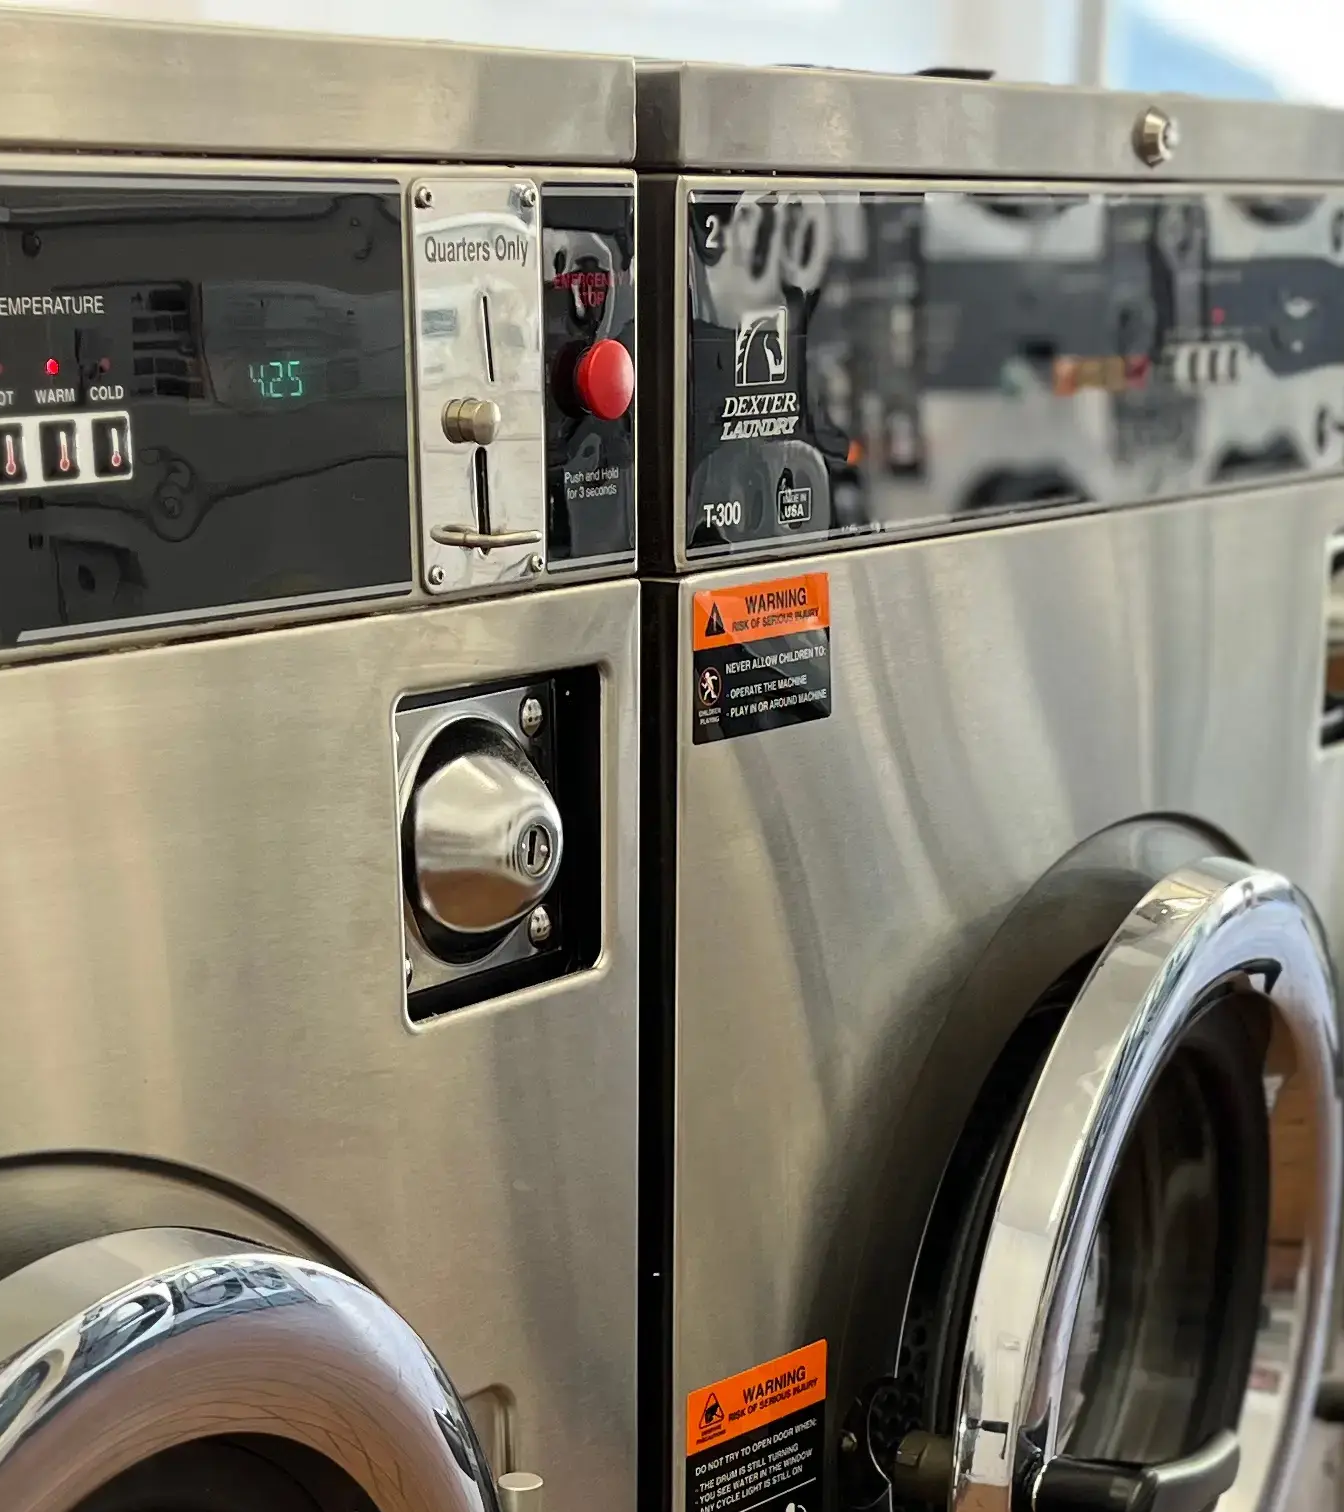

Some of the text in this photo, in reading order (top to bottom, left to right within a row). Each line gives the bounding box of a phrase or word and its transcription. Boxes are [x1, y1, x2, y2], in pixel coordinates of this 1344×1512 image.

[425, 235, 528, 267] Quarters Only
[552, 272, 623, 289] EMERGENY
[579, 291, 604, 308] TOP
[35, 388, 75, 404] WARM
[90, 385, 124, 401] COLD
[721, 392, 797, 418] DEXTER
[720, 416, 799, 440] LAUNDRY
[564, 467, 618, 483] Push and Hold
[567, 484, 617, 499] for 3 seconds
[704, 501, 804, 528] T-300 USA
[745, 588, 806, 615] WARNING
[732, 620, 749, 632] RISK
[751, 618, 760, 629] OF
[762, 612, 793, 627] SERIOUS
[726, 646, 826, 674] NEVER ALLOW CHILDREN TO:
[730, 674, 807, 699] OPERATE THE MACHINE
[730, 689, 827, 718] PLAY IN OR AROUND MACHINE
[743, 1366, 806, 1404] WARNING
[728, 1377, 818, 1422] RISK OF SERIOUS INJURY
[695, 1464, 706, 1477] DO
[708, 1457, 723, 1471] NOT
[724, 1451, 739, 1465] TRY
[740, 1445, 751, 1457] TO
[752, 1436, 772, 1453] OPEN
[773, 1427, 794, 1444] DOOR
[699, 1443, 799, 1493] THE DRUM IS STILL TURNING
[699, 1448, 813, 1505] YOU SEE WATER IN THE WINDOW
[716, 1492, 740, 1510] CYCLE
[741, 1483, 763, 1499] LIGHT
[764, 1478, 771, 1489] IS
[772, 1470, 791, 1485] STILL
[792, 1464, 803, 1476] ON
